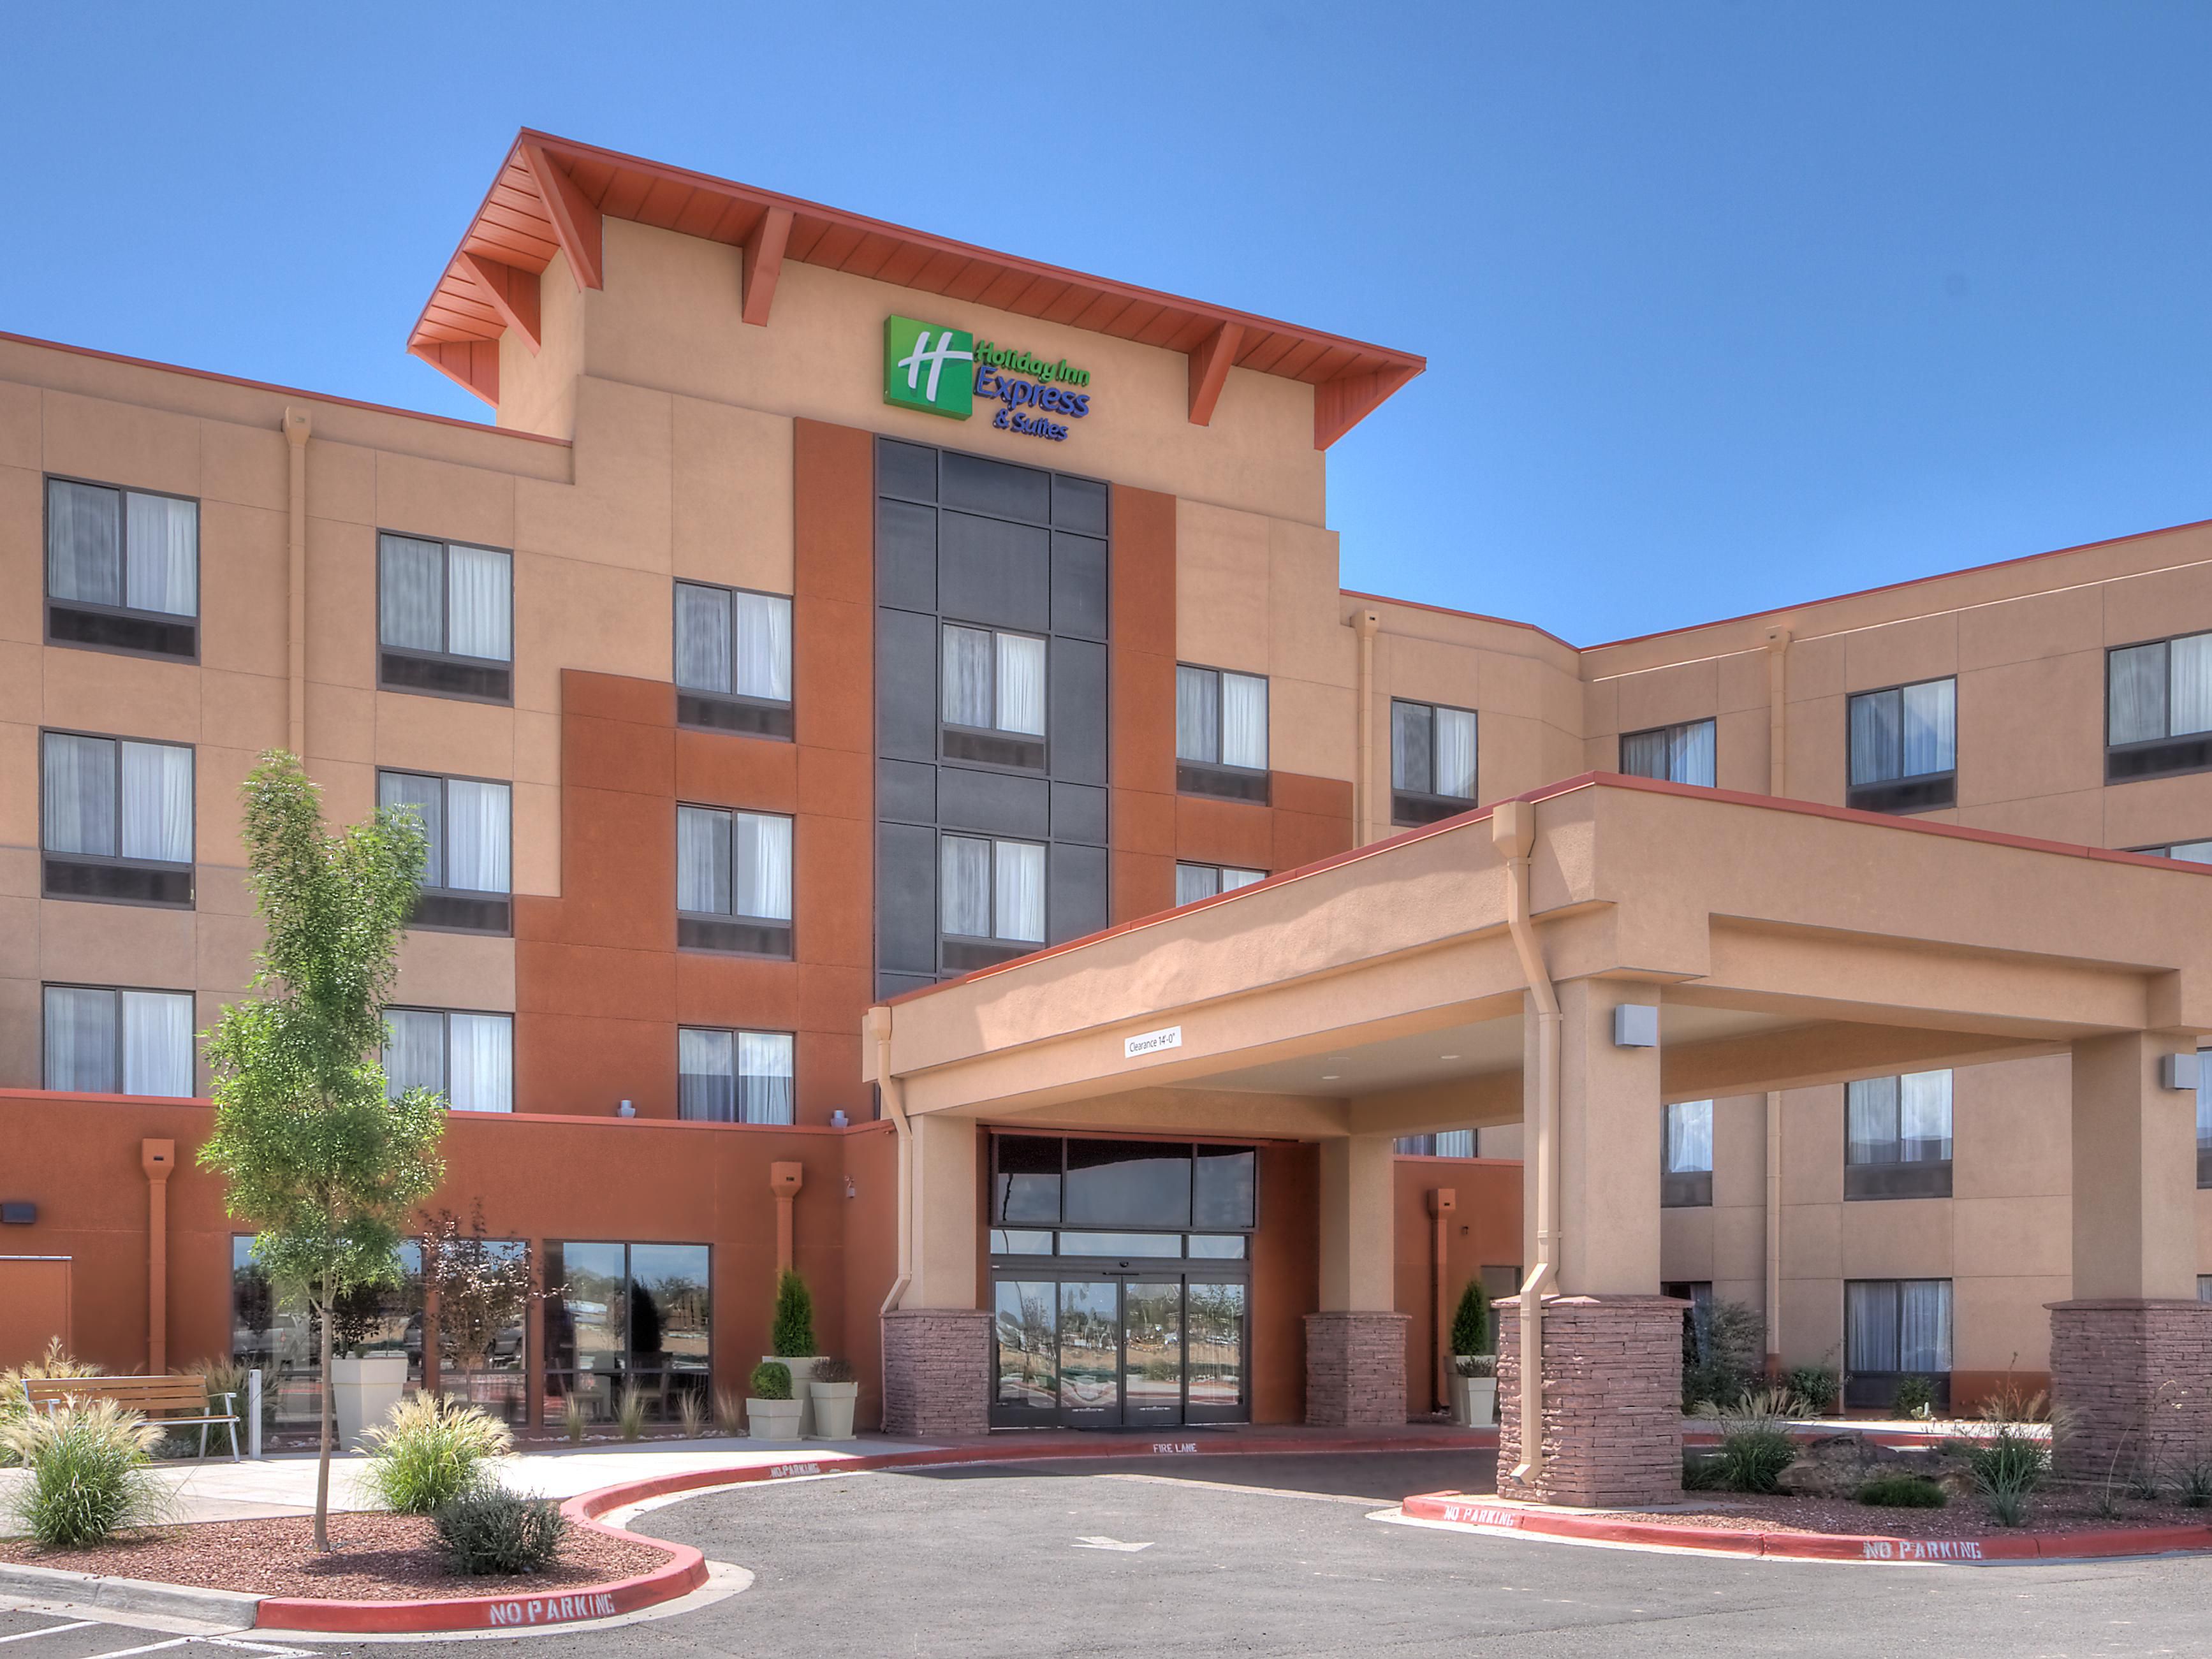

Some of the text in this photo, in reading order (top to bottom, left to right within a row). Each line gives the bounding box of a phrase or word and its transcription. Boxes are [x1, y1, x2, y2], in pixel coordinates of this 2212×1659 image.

[898, 331, 973, 402] H
[975, 340, 1090, 387] Holiday Inn
[974, 365, 1090, 418] Express
[993, 408, 1069, 441] & Suites
[1129, 1039, 1157, 1052] Clearance
[1153, 1443, 1197, 1453] FIRE LANE
[770, 1463, 821, 1478] NO PARKING
[1444, 1505, 1516, 1526] NO PARKING
[1863, 1540, 1982, 1559] NO PARKING
[490, 1593, 615, 1625] NO PARKING
